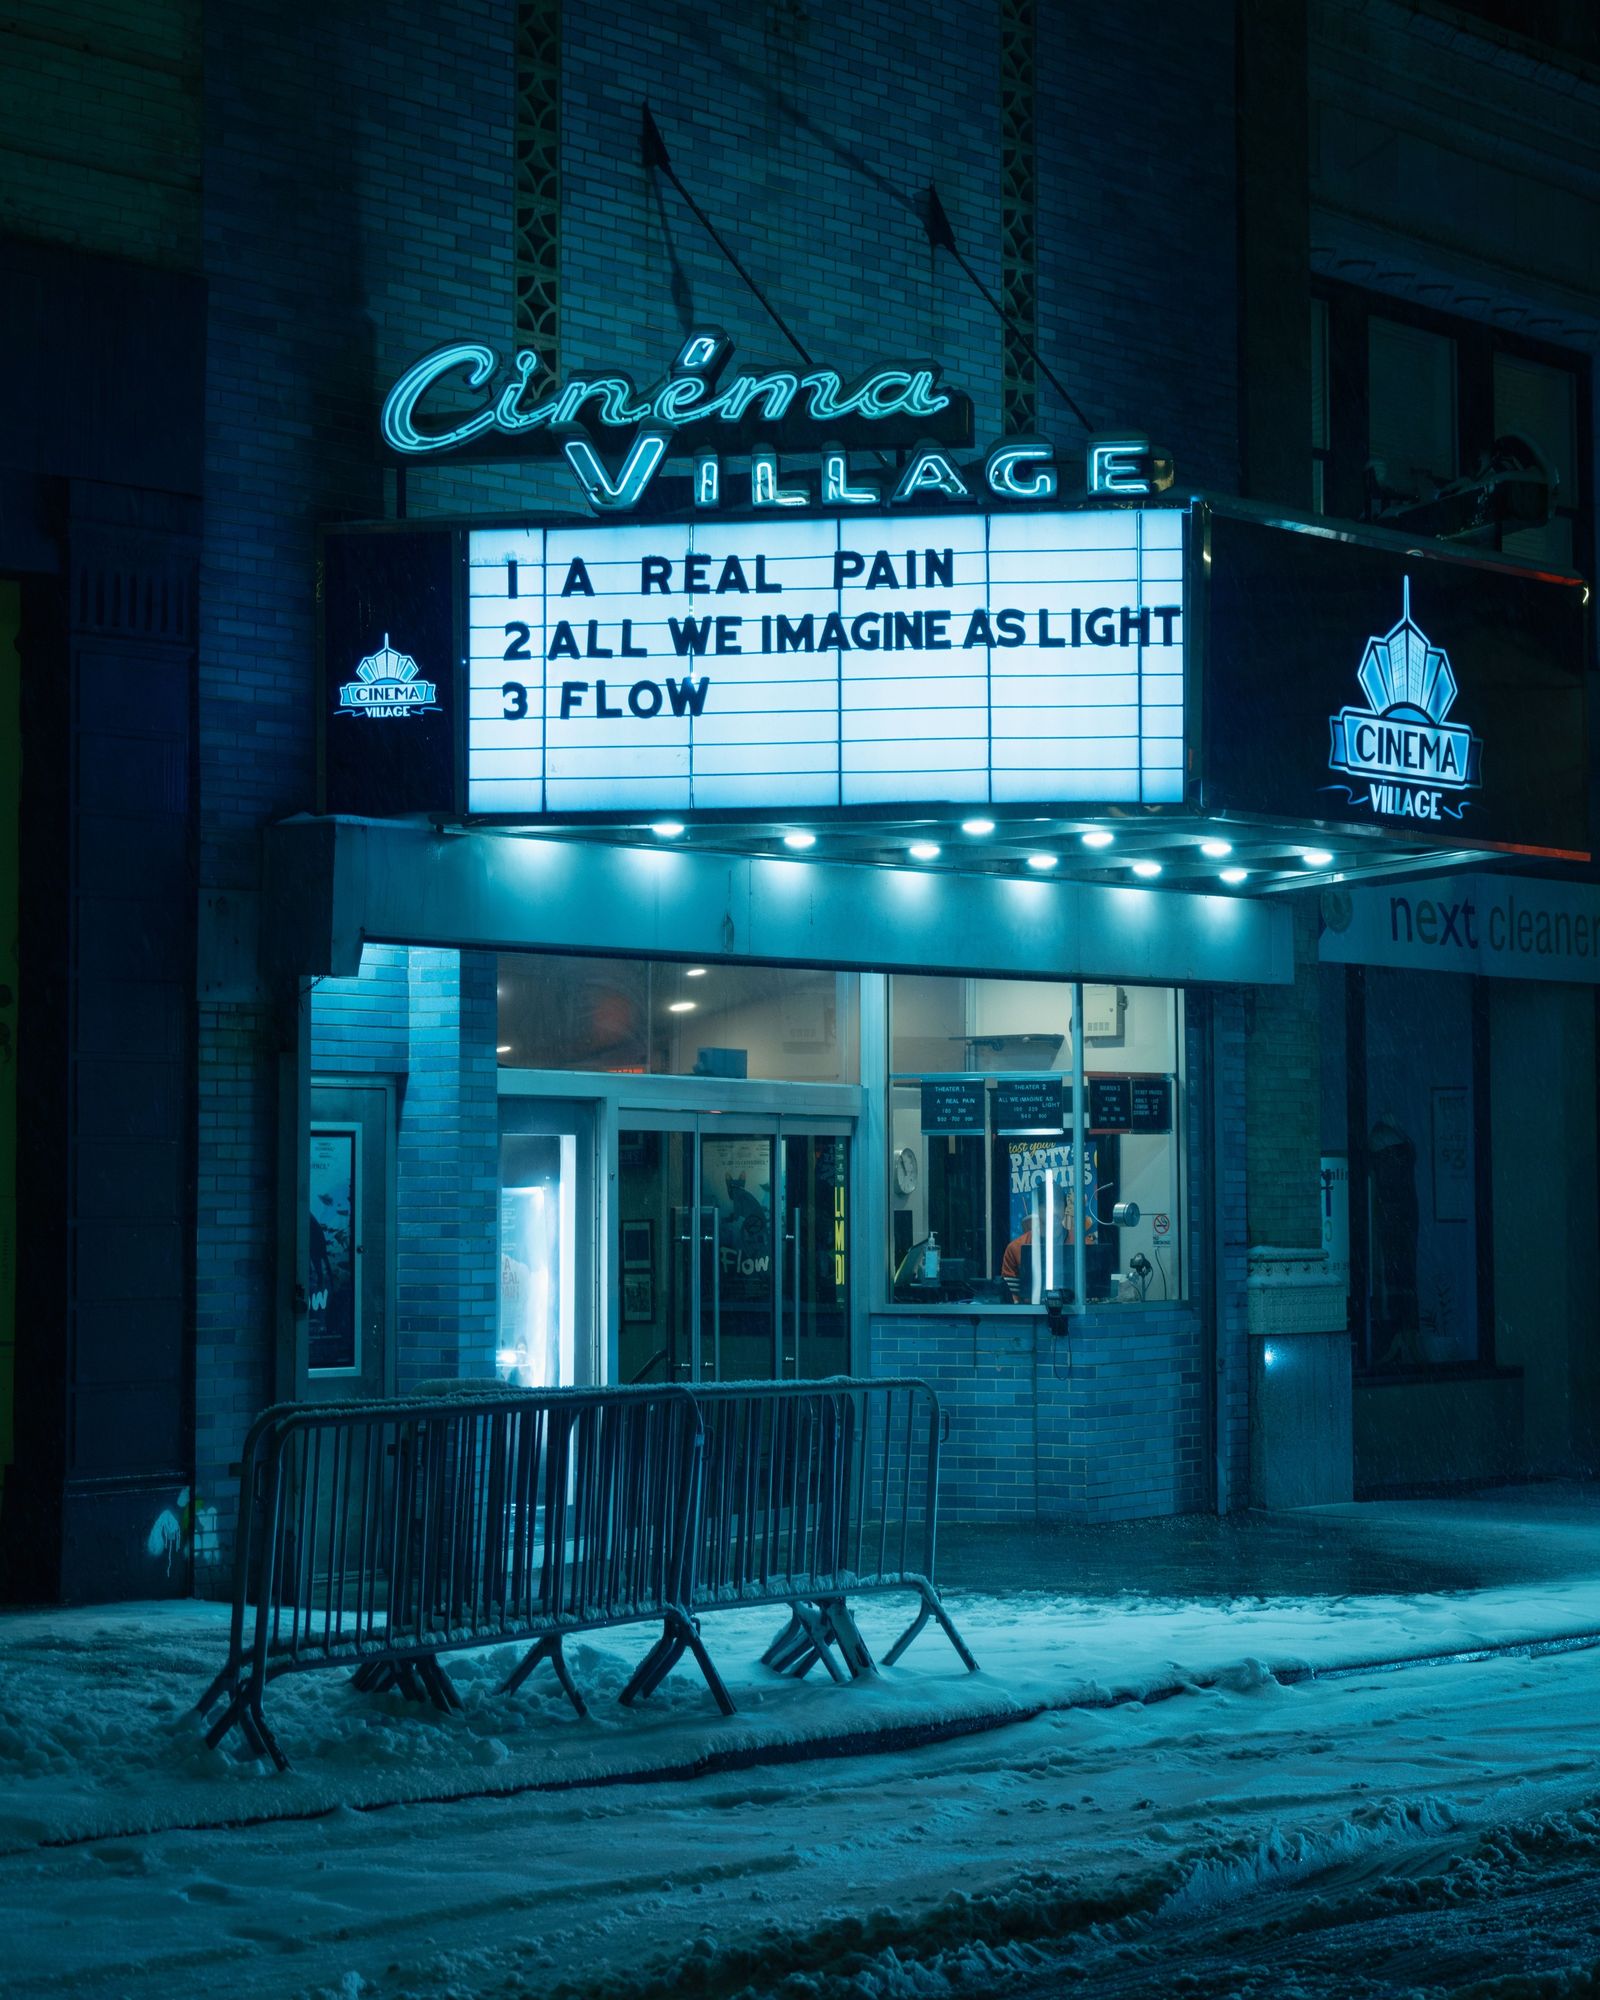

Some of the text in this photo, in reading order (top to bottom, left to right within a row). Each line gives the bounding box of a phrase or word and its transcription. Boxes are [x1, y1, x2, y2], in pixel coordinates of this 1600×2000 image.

[381, 335, 951, 454] Cinéma
[555, 430, 1151, 514] VILLAGE
[561, 557, 595, 597] A
[641, 554, 782, 595] REAL
[833, 548, 954, 590] PAIN
[503, 604, 1181, 660] 2 ALL WE IMAGINE AS LIGHT
[355, 686, 419, 702] CINEMA
[365, 706, 411, 718] VILLAGE
[502, 676, 710, 721] 3 FLOW
[1356, 724, 1458, 775] CINEMA
[1370, 783, 1442, 820] VILLAGE
[1390, 896, 1478, 949] next
[1009, 1145, 1071, 1172] PARTY
